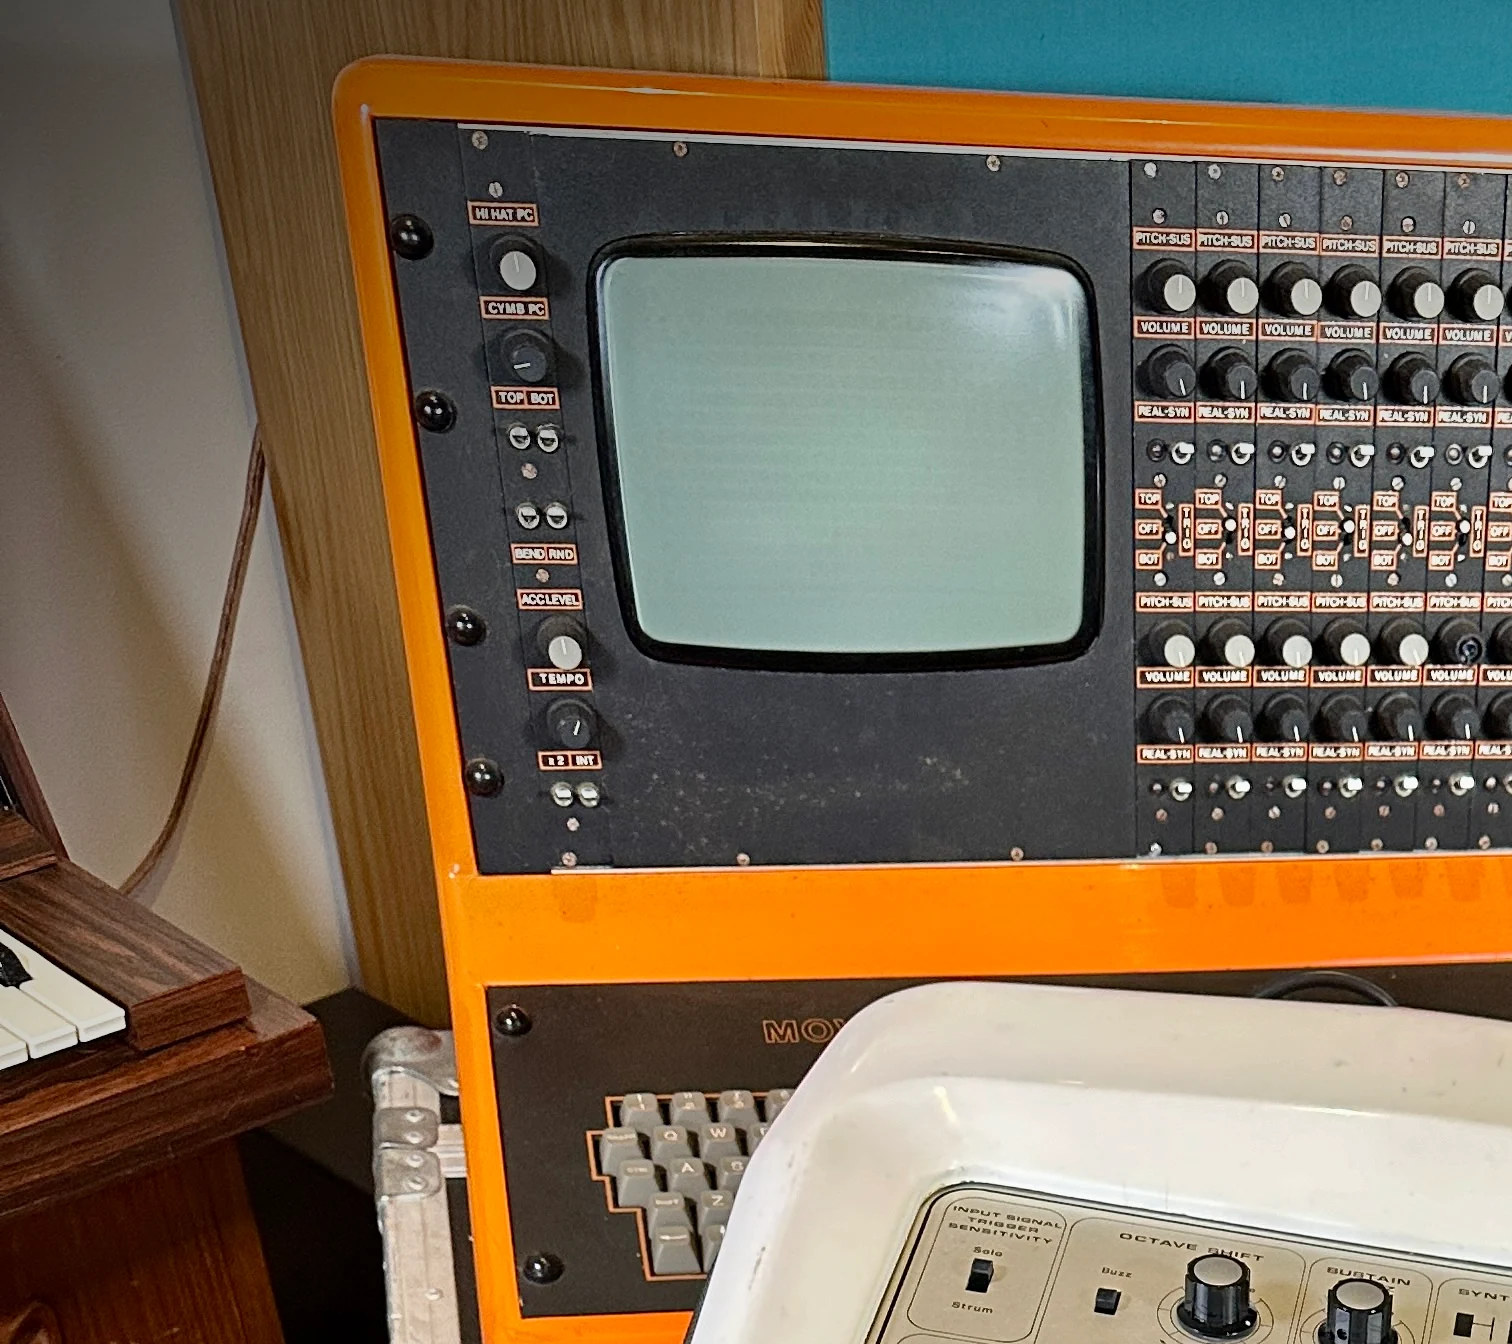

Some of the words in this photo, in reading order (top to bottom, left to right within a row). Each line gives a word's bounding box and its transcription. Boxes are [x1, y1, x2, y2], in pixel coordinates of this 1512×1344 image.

[476, 209, 489, 219] HI
[491, 209, 514, 221] HAT
[516, 210, 533, 221] PC
[1136, 232, 1190, 245] PITCH-SUS
[1199, 235, 1252, 247] PITCH-SUS
[1261, 236, 1315, 249] PITCH-SUS
[1322, 239, 1376, 252] PITCH-SUS
[1385, 241, 1437, 254] PITCH-SUS
[1445, 242, 1497, 255] PITCH-SUS
[488, 302, 525, 315] CYMB
[528, 304, 544, 315] PC
[1141, 321, 1189, 334] VOLUME
[1202, 323, 1249, 335] VOLUME
[1265, 324, 1312, 336] VOLUME
[1324, 326, 1372, 339] VOLUME
[1385, 328, 1431, 340] VOLUME
[1445, 329, 1491, 341] VOLUME
[499, 391, 524, 403] TOP
[531, 393, 554, 404] BOT
[1139, 494, 1160, 504] TOP
[1198, 494, 1219, 504] TOP
[1139, 524, 1159, 534] OFF
[1198, 524, 1218, 534] OFF
[515, 548, 546, 560] BEND
[549, 549, 574, 560] RND
[539, 673, 584, 685] TEMPO
[1145, 671, 1190, 682] VOLUME
[1203, 671, 1247, 682] VOLUME
[1261, 670, 1305, 681] VOLUME
[575, 755, 594, 766] INT
[664, 1130, 678, 1141] Q
[710, 1127, 727, 1139] W
[681, 1162, 695, 1173] A
[712, 1195, 725, 1207] Z
[953, 1205, 1002, 1219] INPUT
[1006, 1214, 1062, 1230] SIGNAL
[968, 1216, 1039, 1233] TRIGGER
[949, 1222, 1053, 1245] SENSITIVITY
[973, 1246, 1003, 1257] Solo
[1119, 1232, 1197, 1251] OCTAVE
[1208, 1247, 1264, 1262] SHIFT
[1101, 1266, 1132, 1279] Buzz
[1327, 1266, 1411, 1286] SUSTAIN
[951, 1301, 993, 1315] Strum
